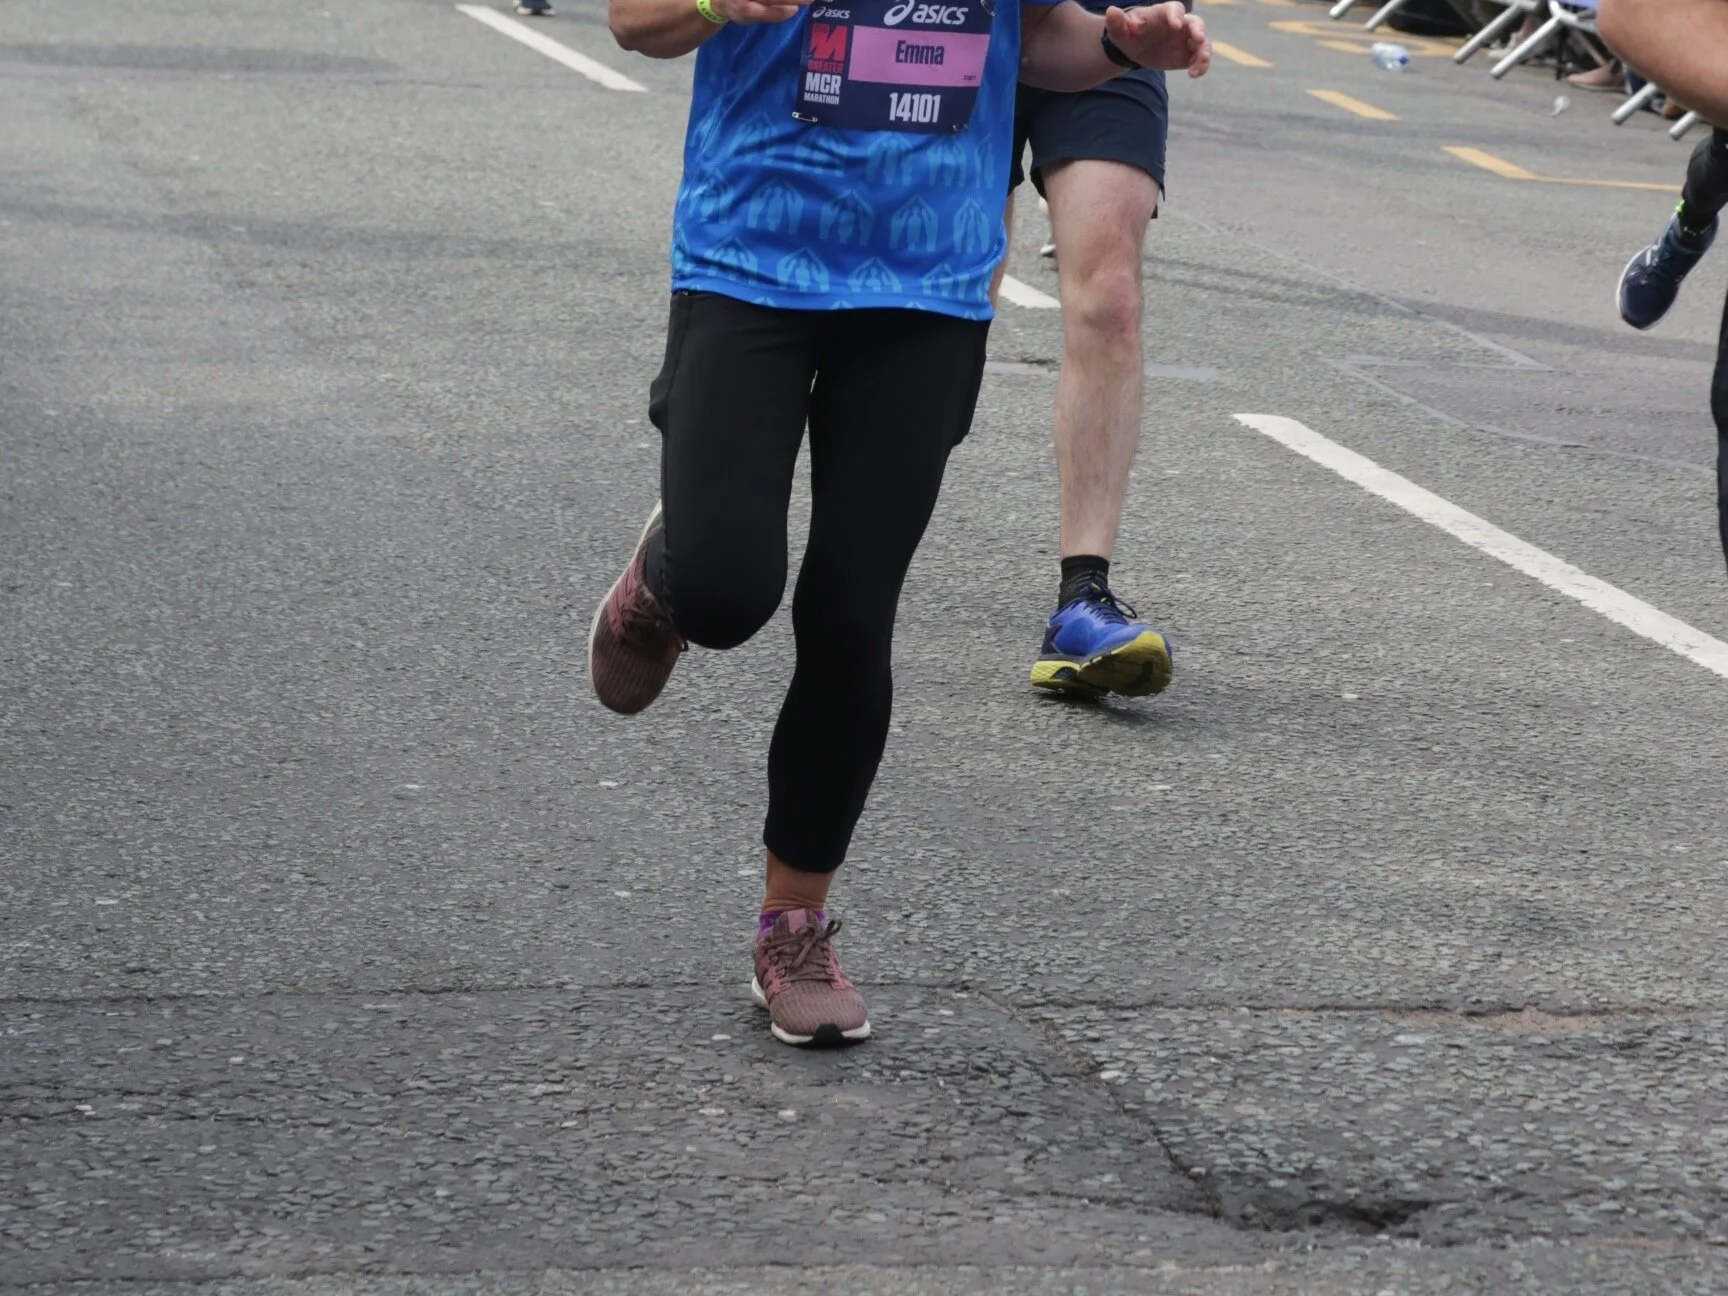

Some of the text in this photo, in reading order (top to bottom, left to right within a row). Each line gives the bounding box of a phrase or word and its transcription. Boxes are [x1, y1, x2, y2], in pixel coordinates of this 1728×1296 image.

[824, 8, 851, 19] asics
[912, 4, 969, 25] asics
[895, 40, 945, 66] Emma
[805, 72, 842, 95] MCR
[803, 91, 840, 105] MARATHON
[889, 92, 941, 123] 14101
